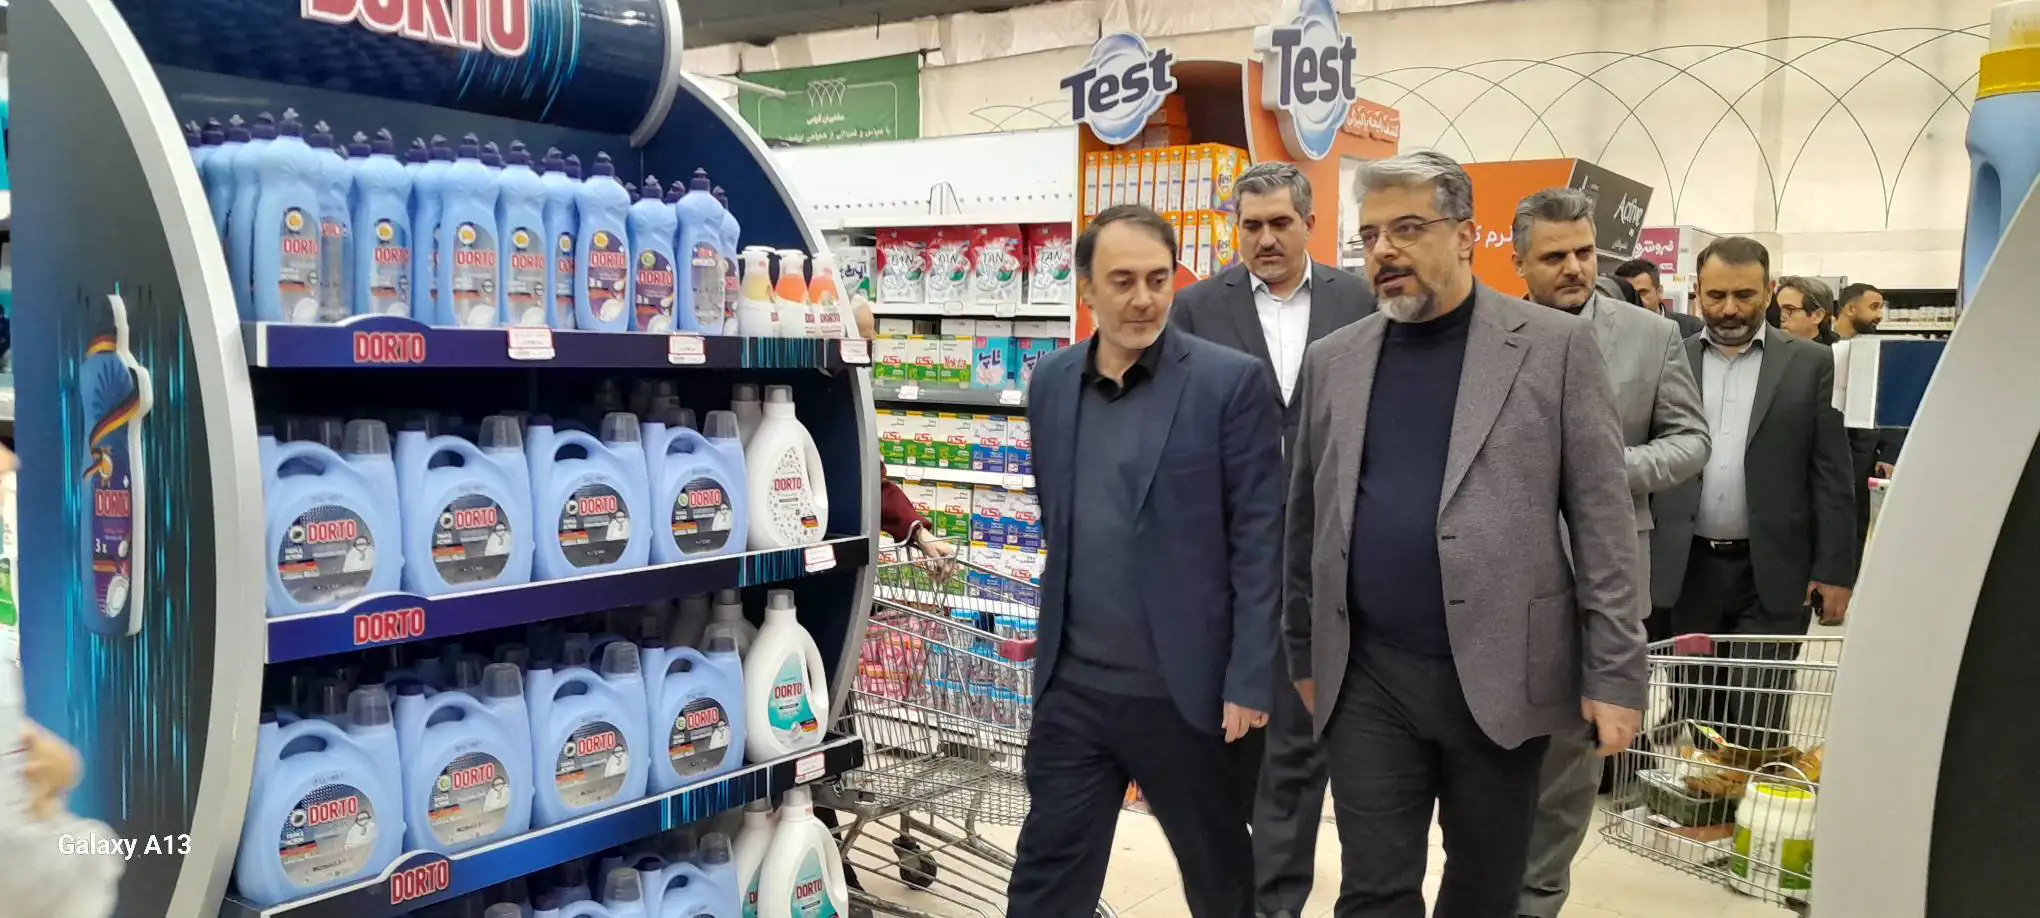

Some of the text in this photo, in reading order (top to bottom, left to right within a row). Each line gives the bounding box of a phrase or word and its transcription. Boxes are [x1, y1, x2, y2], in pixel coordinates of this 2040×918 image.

[1271, 28, 1357, 107] Test
[1059, 47, 1173, 121] Test
[1612, 192, 1644, 228] Active
[353, 331, 426, 363] DORTO
[774, 477, 802, 492] DORTO
[579, 495, 618, 516] DORTO
[688, 488, 722, 509] DORTO
[306, 519, 358, 545] DORTO
[454, 507, 498, 530] DORTO
[353, 606, 425, 646] DORTO
[774, 682, 803, 700] DORTO
[686, 706, 720, 731] DORTO
[576, 730, 617, 757] DORTO
[452, 762, 496, 792] DORTO
[307, 795, 359, 827] DORTO
[390, 859, 449, 905] DORTO
[796, 878, 823, 900] DORTO
